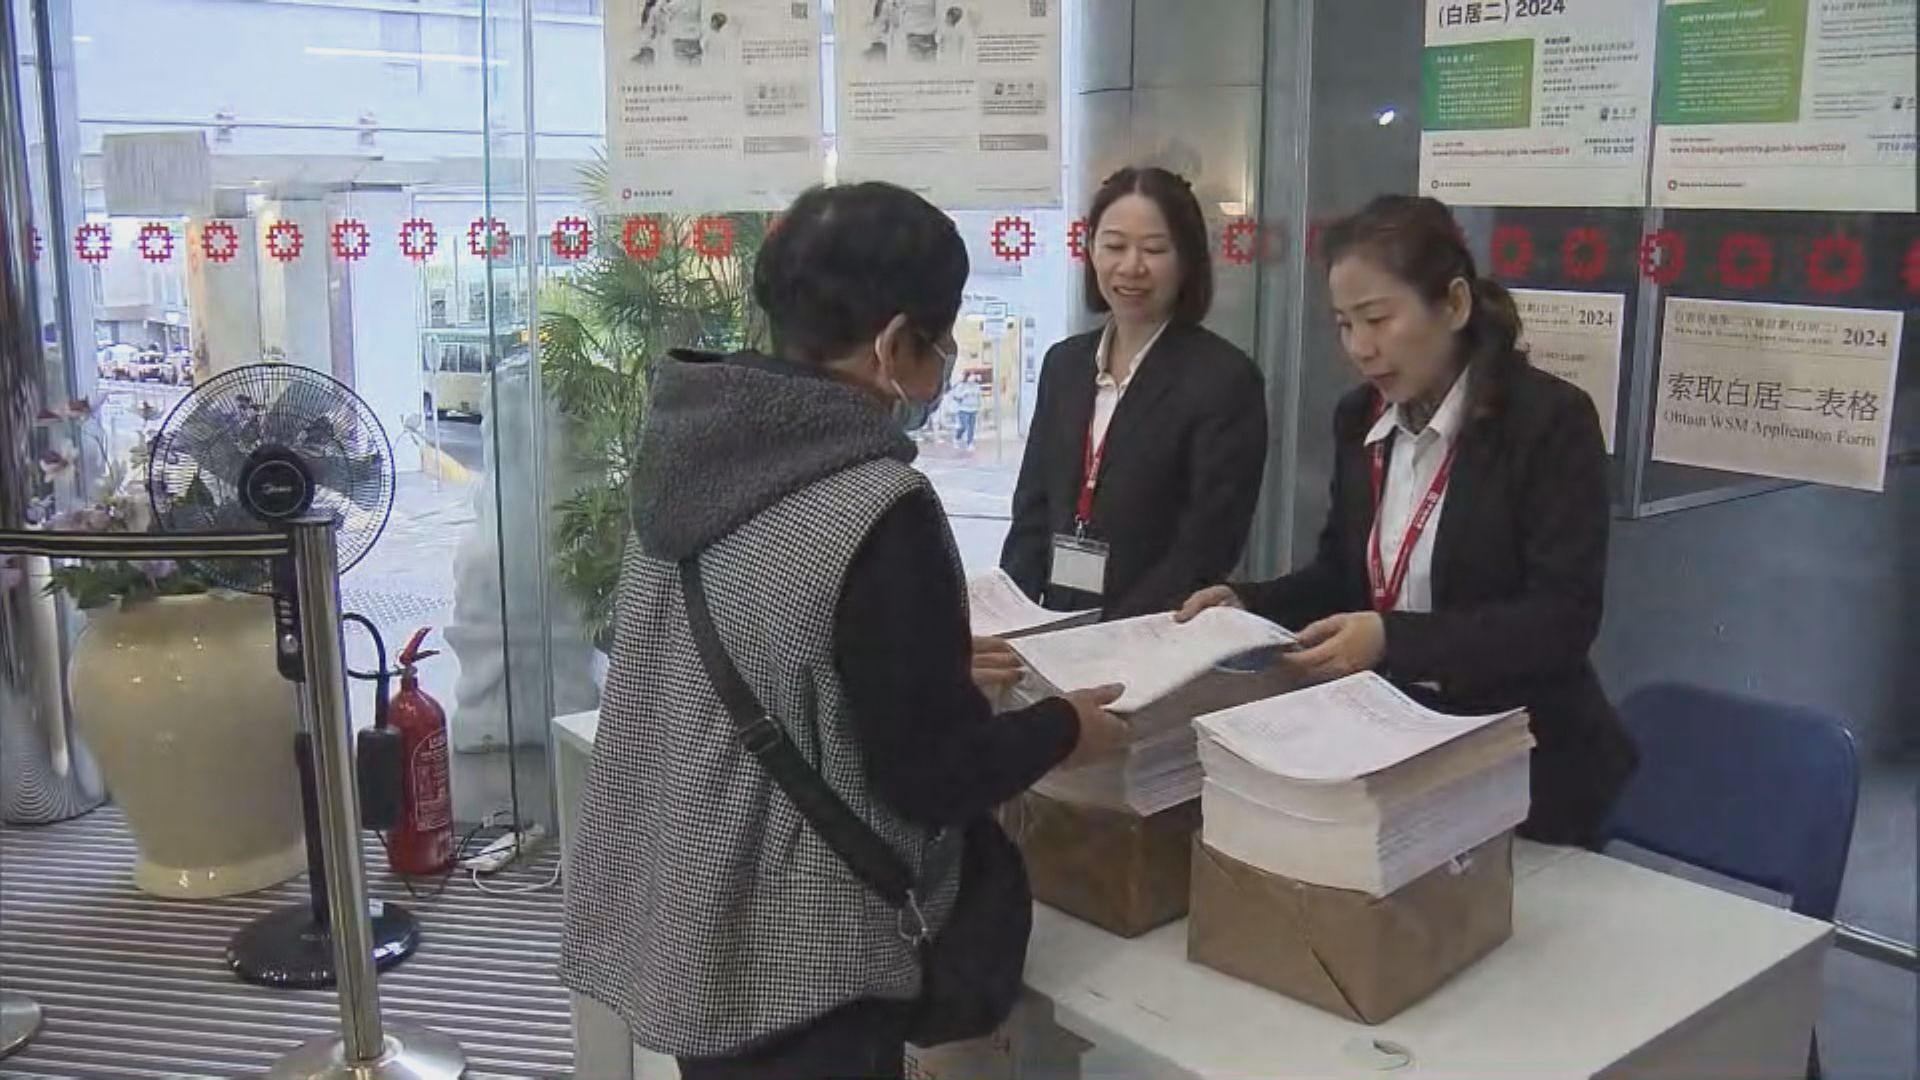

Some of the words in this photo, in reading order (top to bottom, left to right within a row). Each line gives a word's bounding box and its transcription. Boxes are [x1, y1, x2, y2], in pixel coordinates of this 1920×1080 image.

[1439, 0, 1510, 28] (白居二)
[1516, 0, 1566, 17] 2024
[1578, 309, 1613, 326] 2024
[1843, 328, 1887, 347] 2024
[1667, 372, 1879, 422] 索取白居二表格
[1664, 410, 1707, 427] Obtain
[1711, 414, 1748, 432] WSM
[1752, 421, 1832, 443] Application
[1836, 431, 1876, 448] Form
